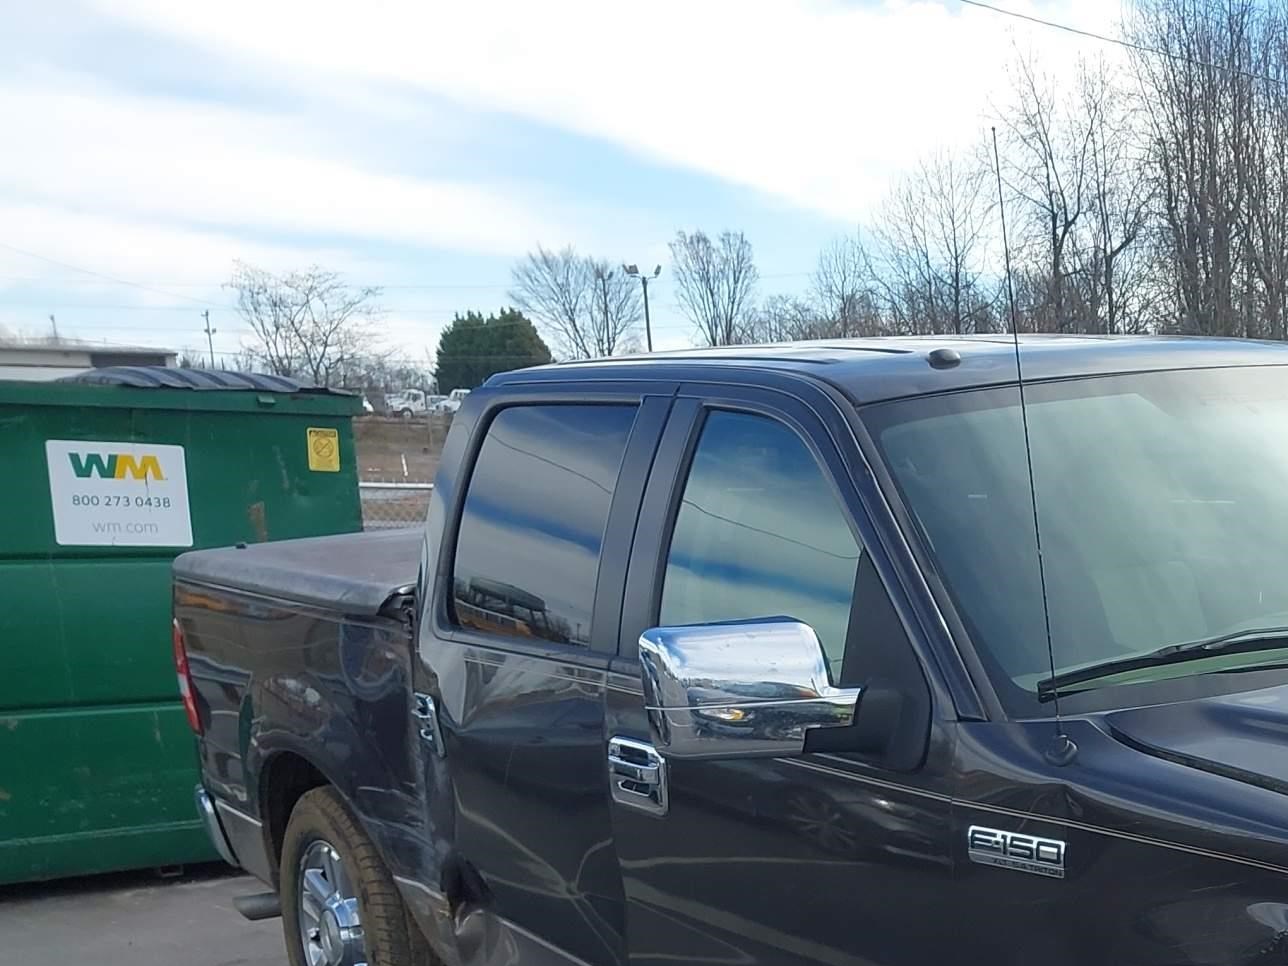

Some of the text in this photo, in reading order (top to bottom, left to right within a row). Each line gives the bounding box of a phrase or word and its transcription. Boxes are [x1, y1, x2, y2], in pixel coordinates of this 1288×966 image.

[68, 452, 164, 481] WM
[72, 494, 171, 509] 800 273 0438
[970, 828, 1063, 866] F-150
